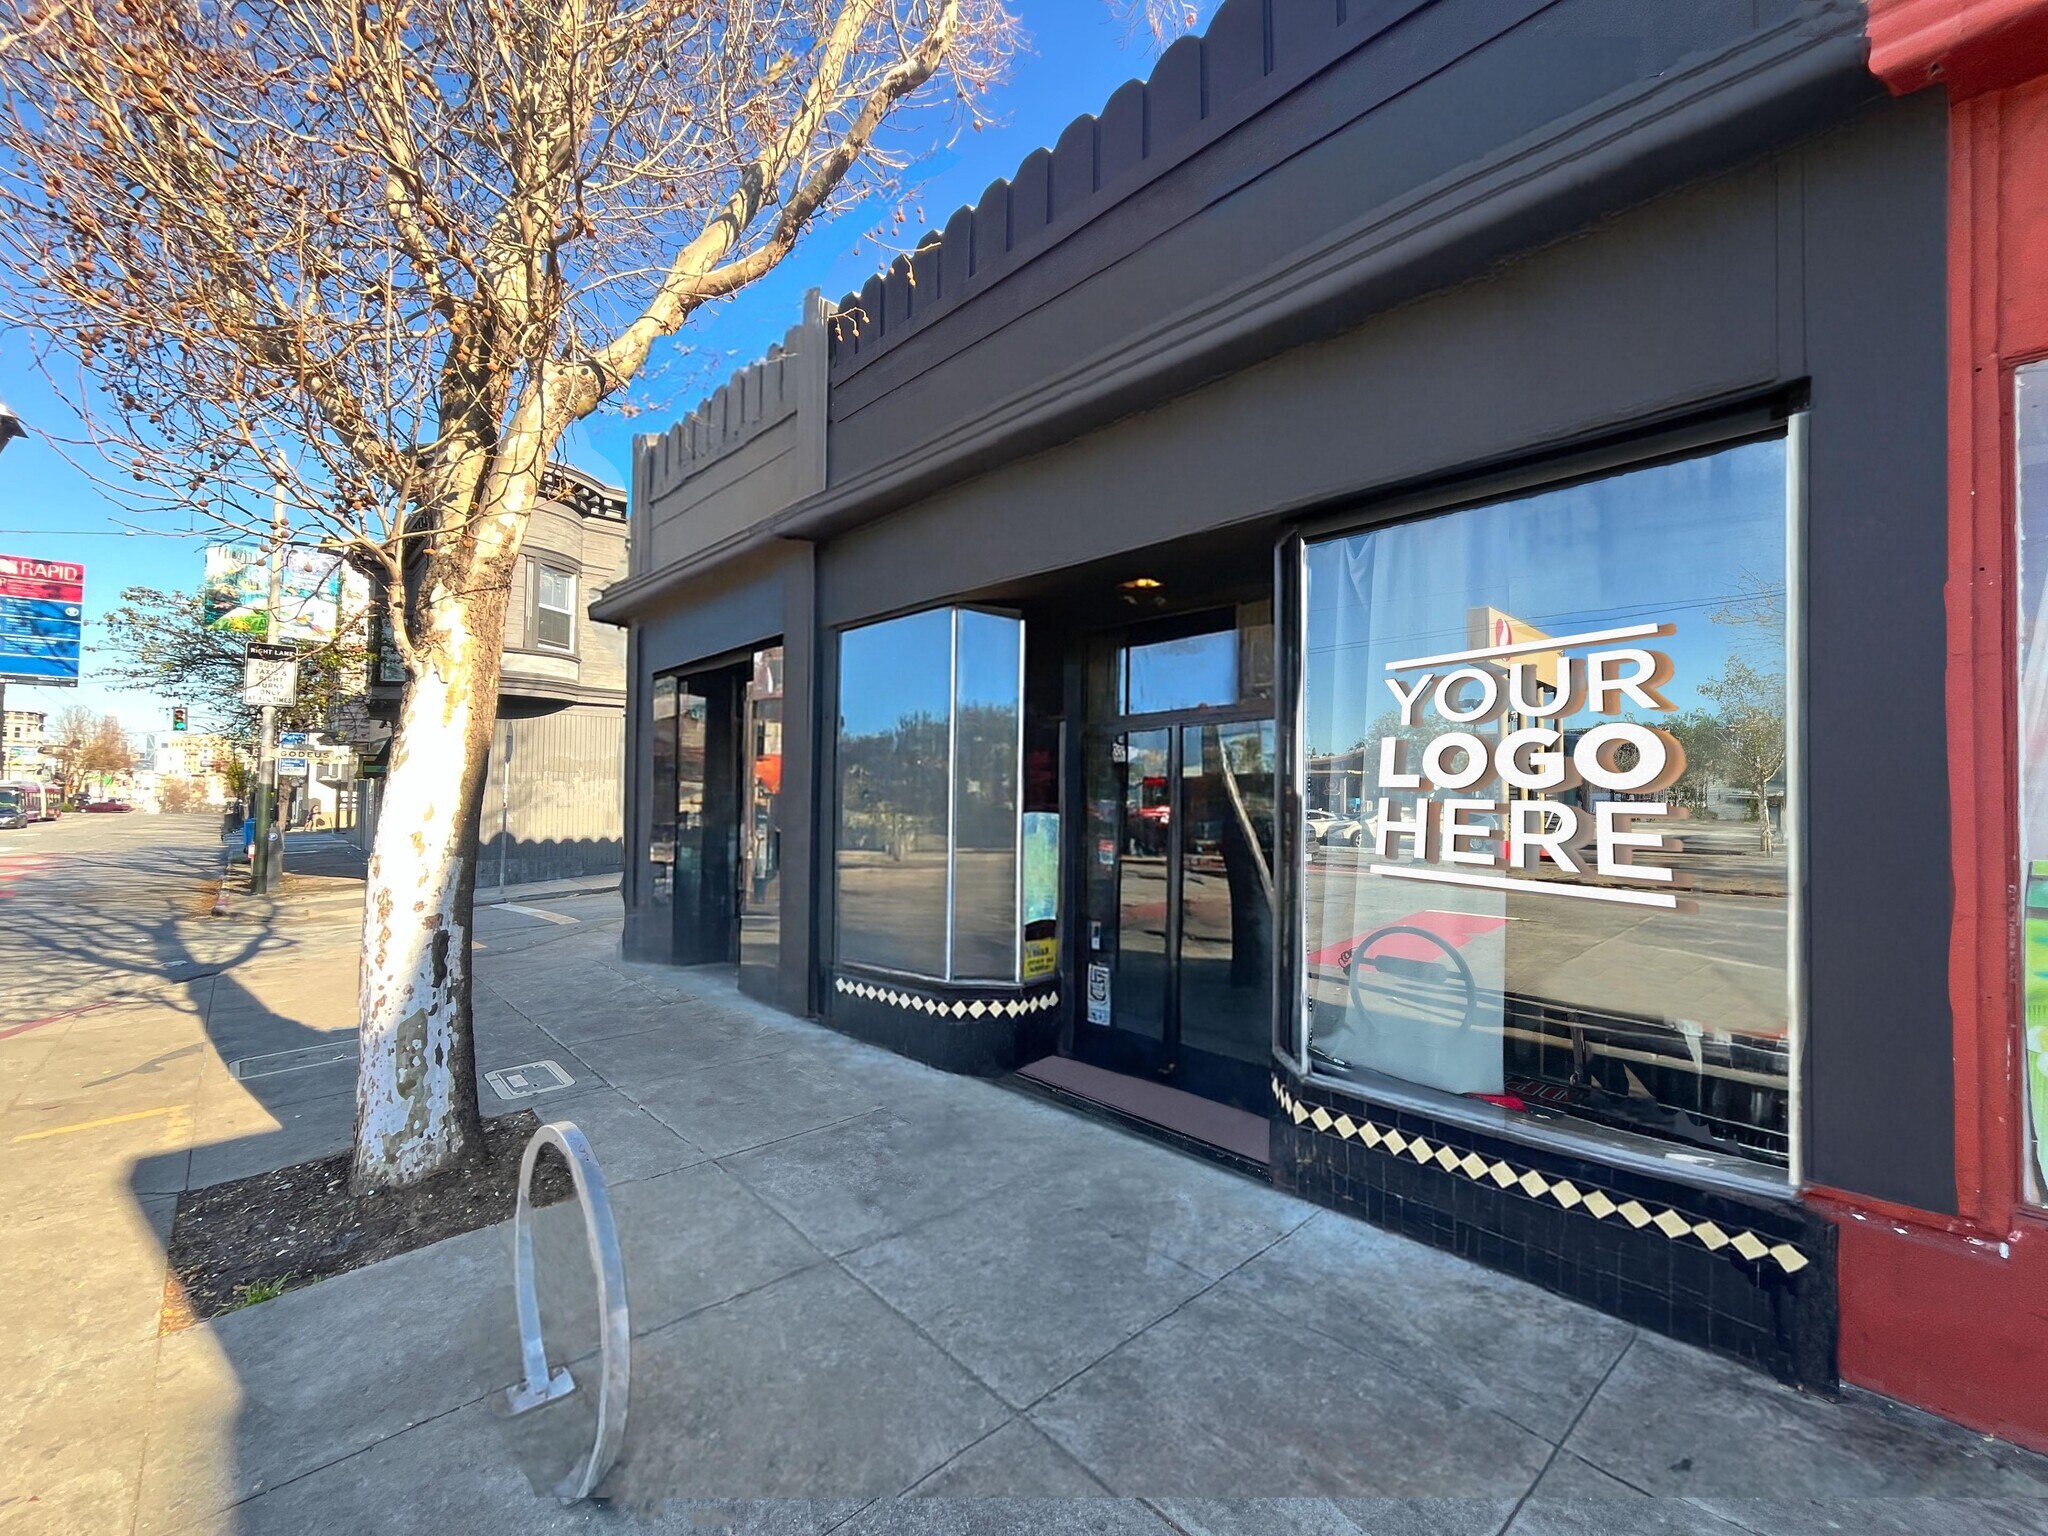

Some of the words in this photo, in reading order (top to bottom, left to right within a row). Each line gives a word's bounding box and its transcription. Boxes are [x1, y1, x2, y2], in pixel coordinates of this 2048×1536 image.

[21, 561, 77, 581] RAPID
[1384, 649, 1661, 726] YOUR
[280, 750, 330, 759] GODEUS
[1378, 722, 1667, 791] LOGO
[1375, 797, 1673, 882] HERE
